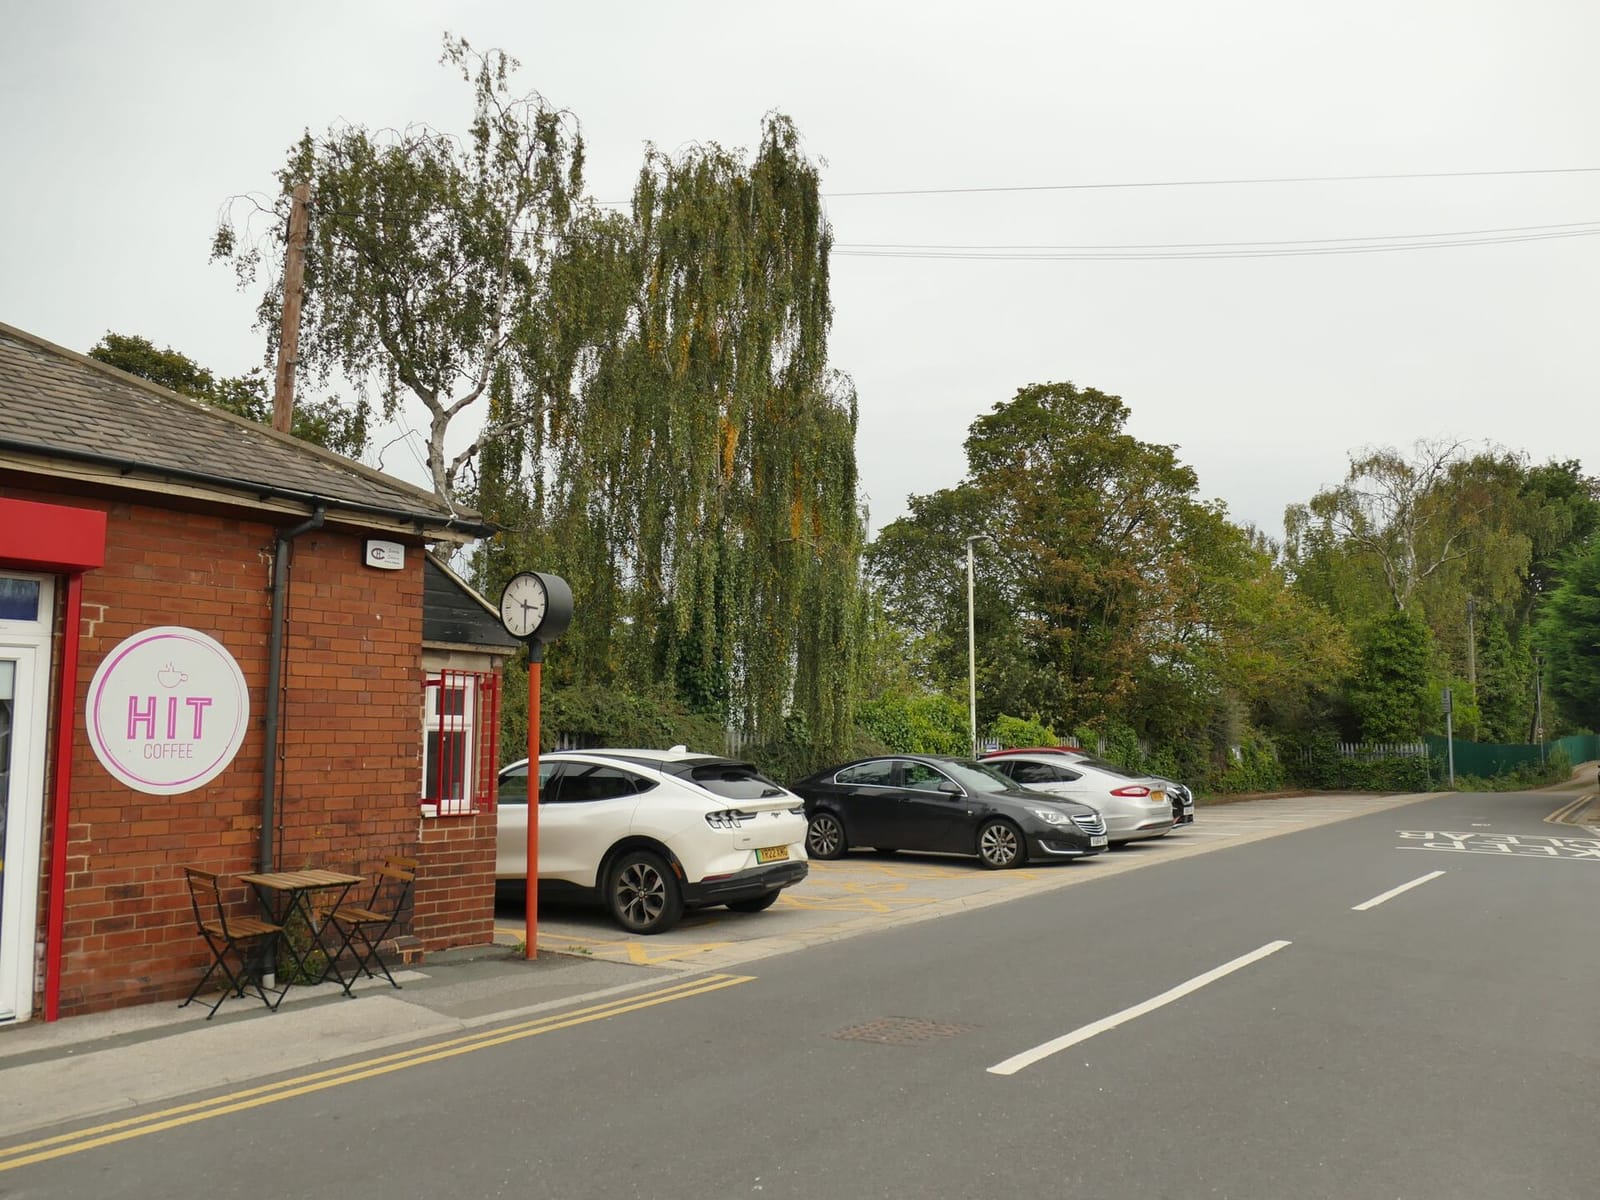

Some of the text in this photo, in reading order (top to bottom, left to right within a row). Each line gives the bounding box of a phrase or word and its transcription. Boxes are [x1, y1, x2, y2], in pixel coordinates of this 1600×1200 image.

[127, 696, 212, 739] HIT
[144, 743, 194, 759] COFFEE
[1400, 832, 1600, 848] CLEAR
[1424, 841, 1600, 858] KEEP
